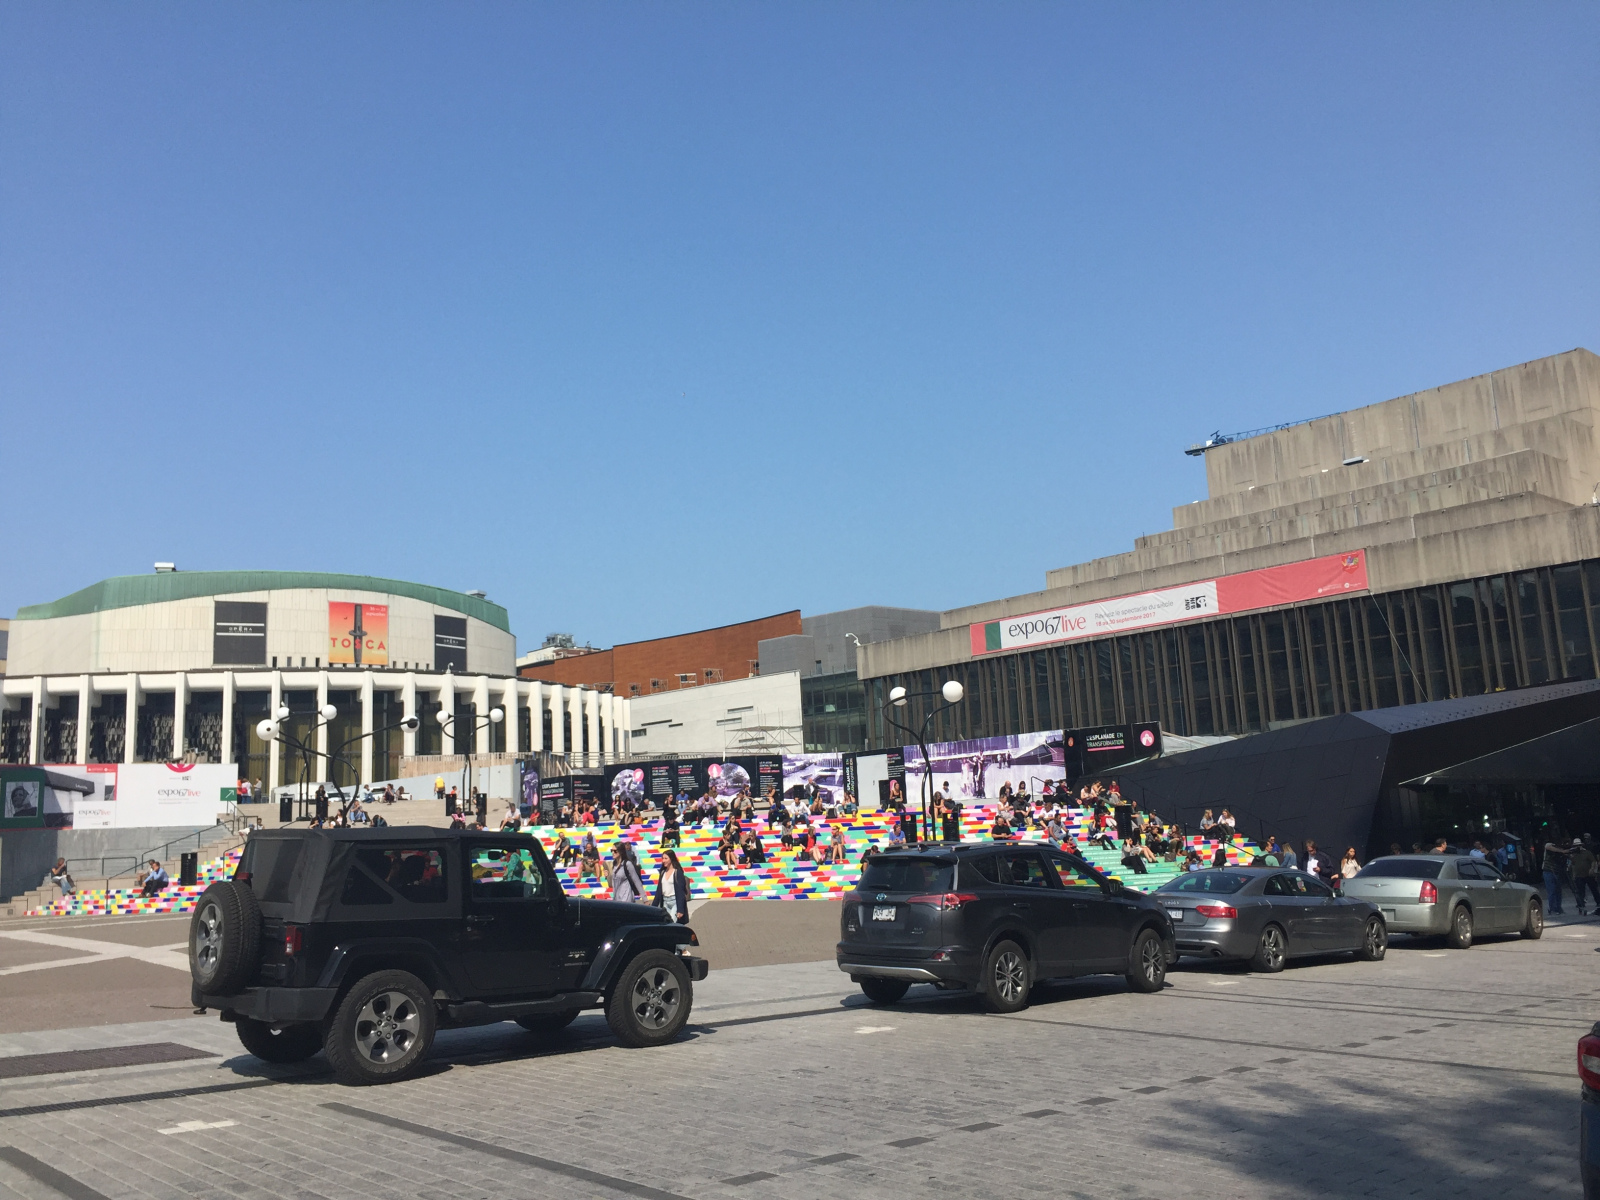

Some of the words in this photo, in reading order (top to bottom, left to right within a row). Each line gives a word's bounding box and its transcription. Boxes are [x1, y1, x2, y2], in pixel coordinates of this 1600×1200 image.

[1121, 605, 1147, 615] spectacle
[1116, 614, 1142, 624] septembre
[330, 637, 387, 650] TOSCA
[1087, 739, 1124, 747] TRANSFORMATION
